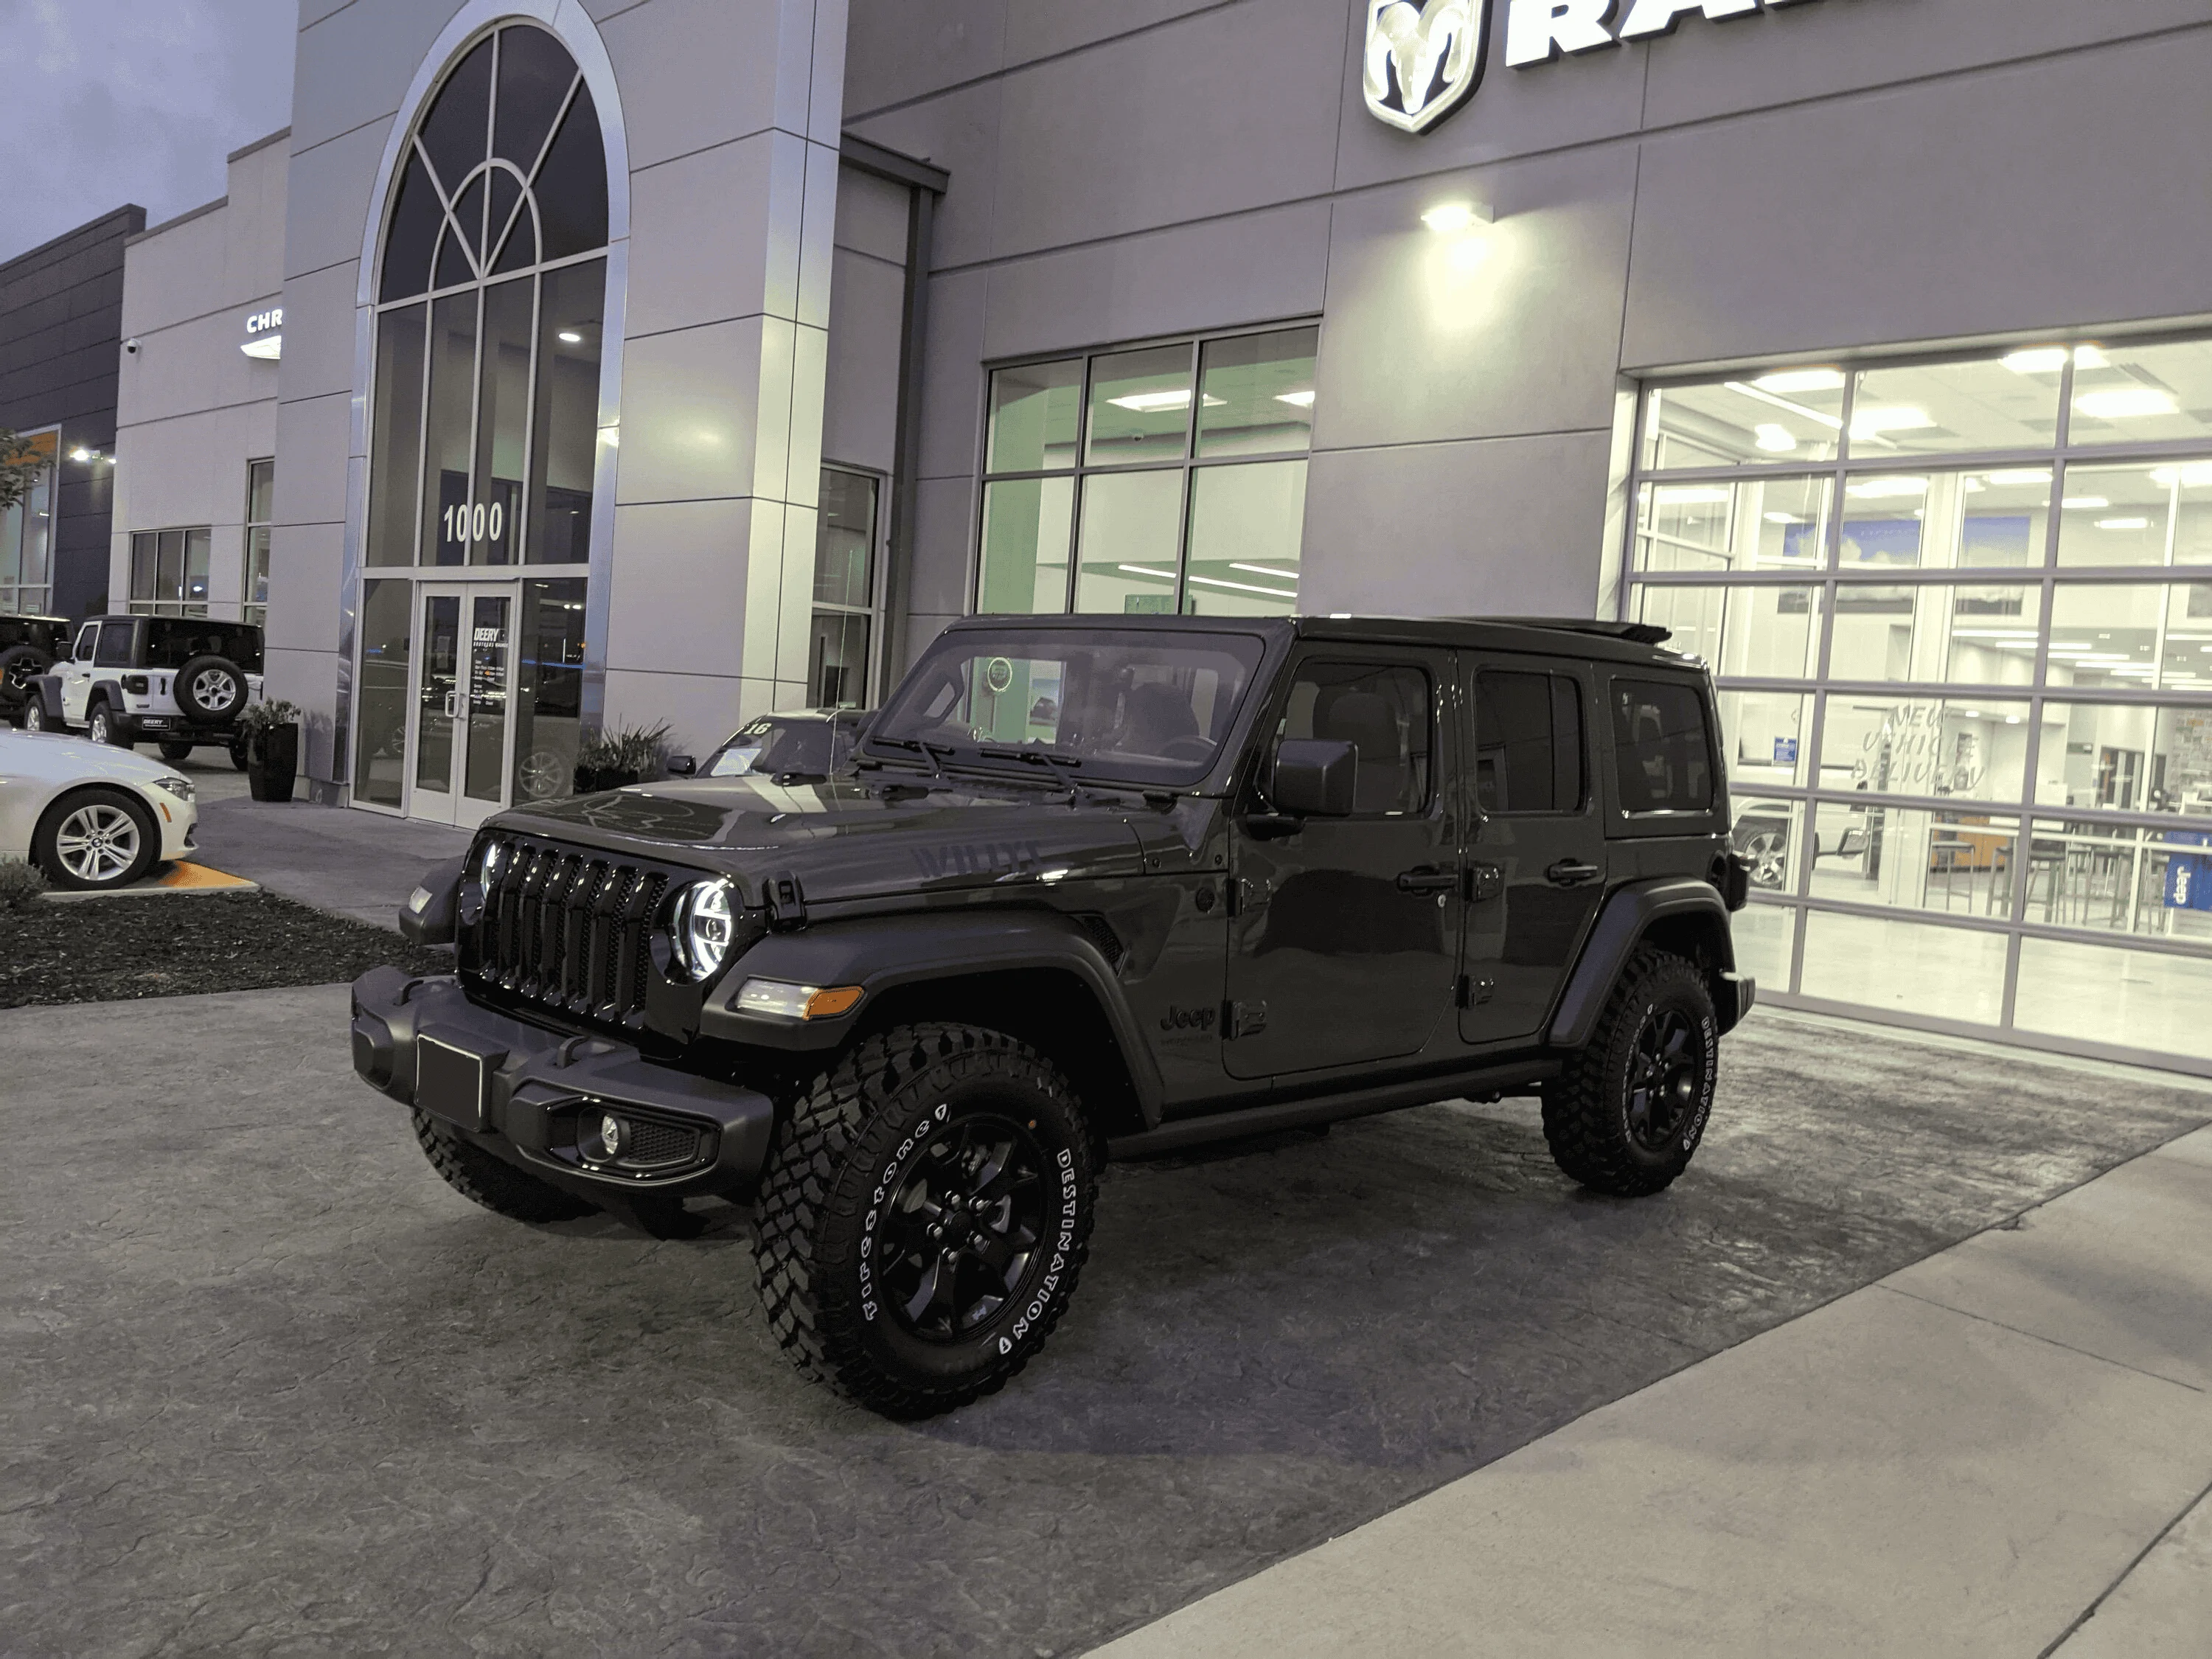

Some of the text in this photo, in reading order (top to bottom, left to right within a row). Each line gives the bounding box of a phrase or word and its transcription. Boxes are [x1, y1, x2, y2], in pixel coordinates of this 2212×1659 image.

[444, 502, 502, 542] 1000
[473, 627, 500, 641] DEERY
[743, 723, 772, 735] 16
[2173, 866, 2191, 905] Jeep
[1160, 1005, 1216, 1031] Jeep
[1012, 1147, 1077, 1340] DESTINATION
